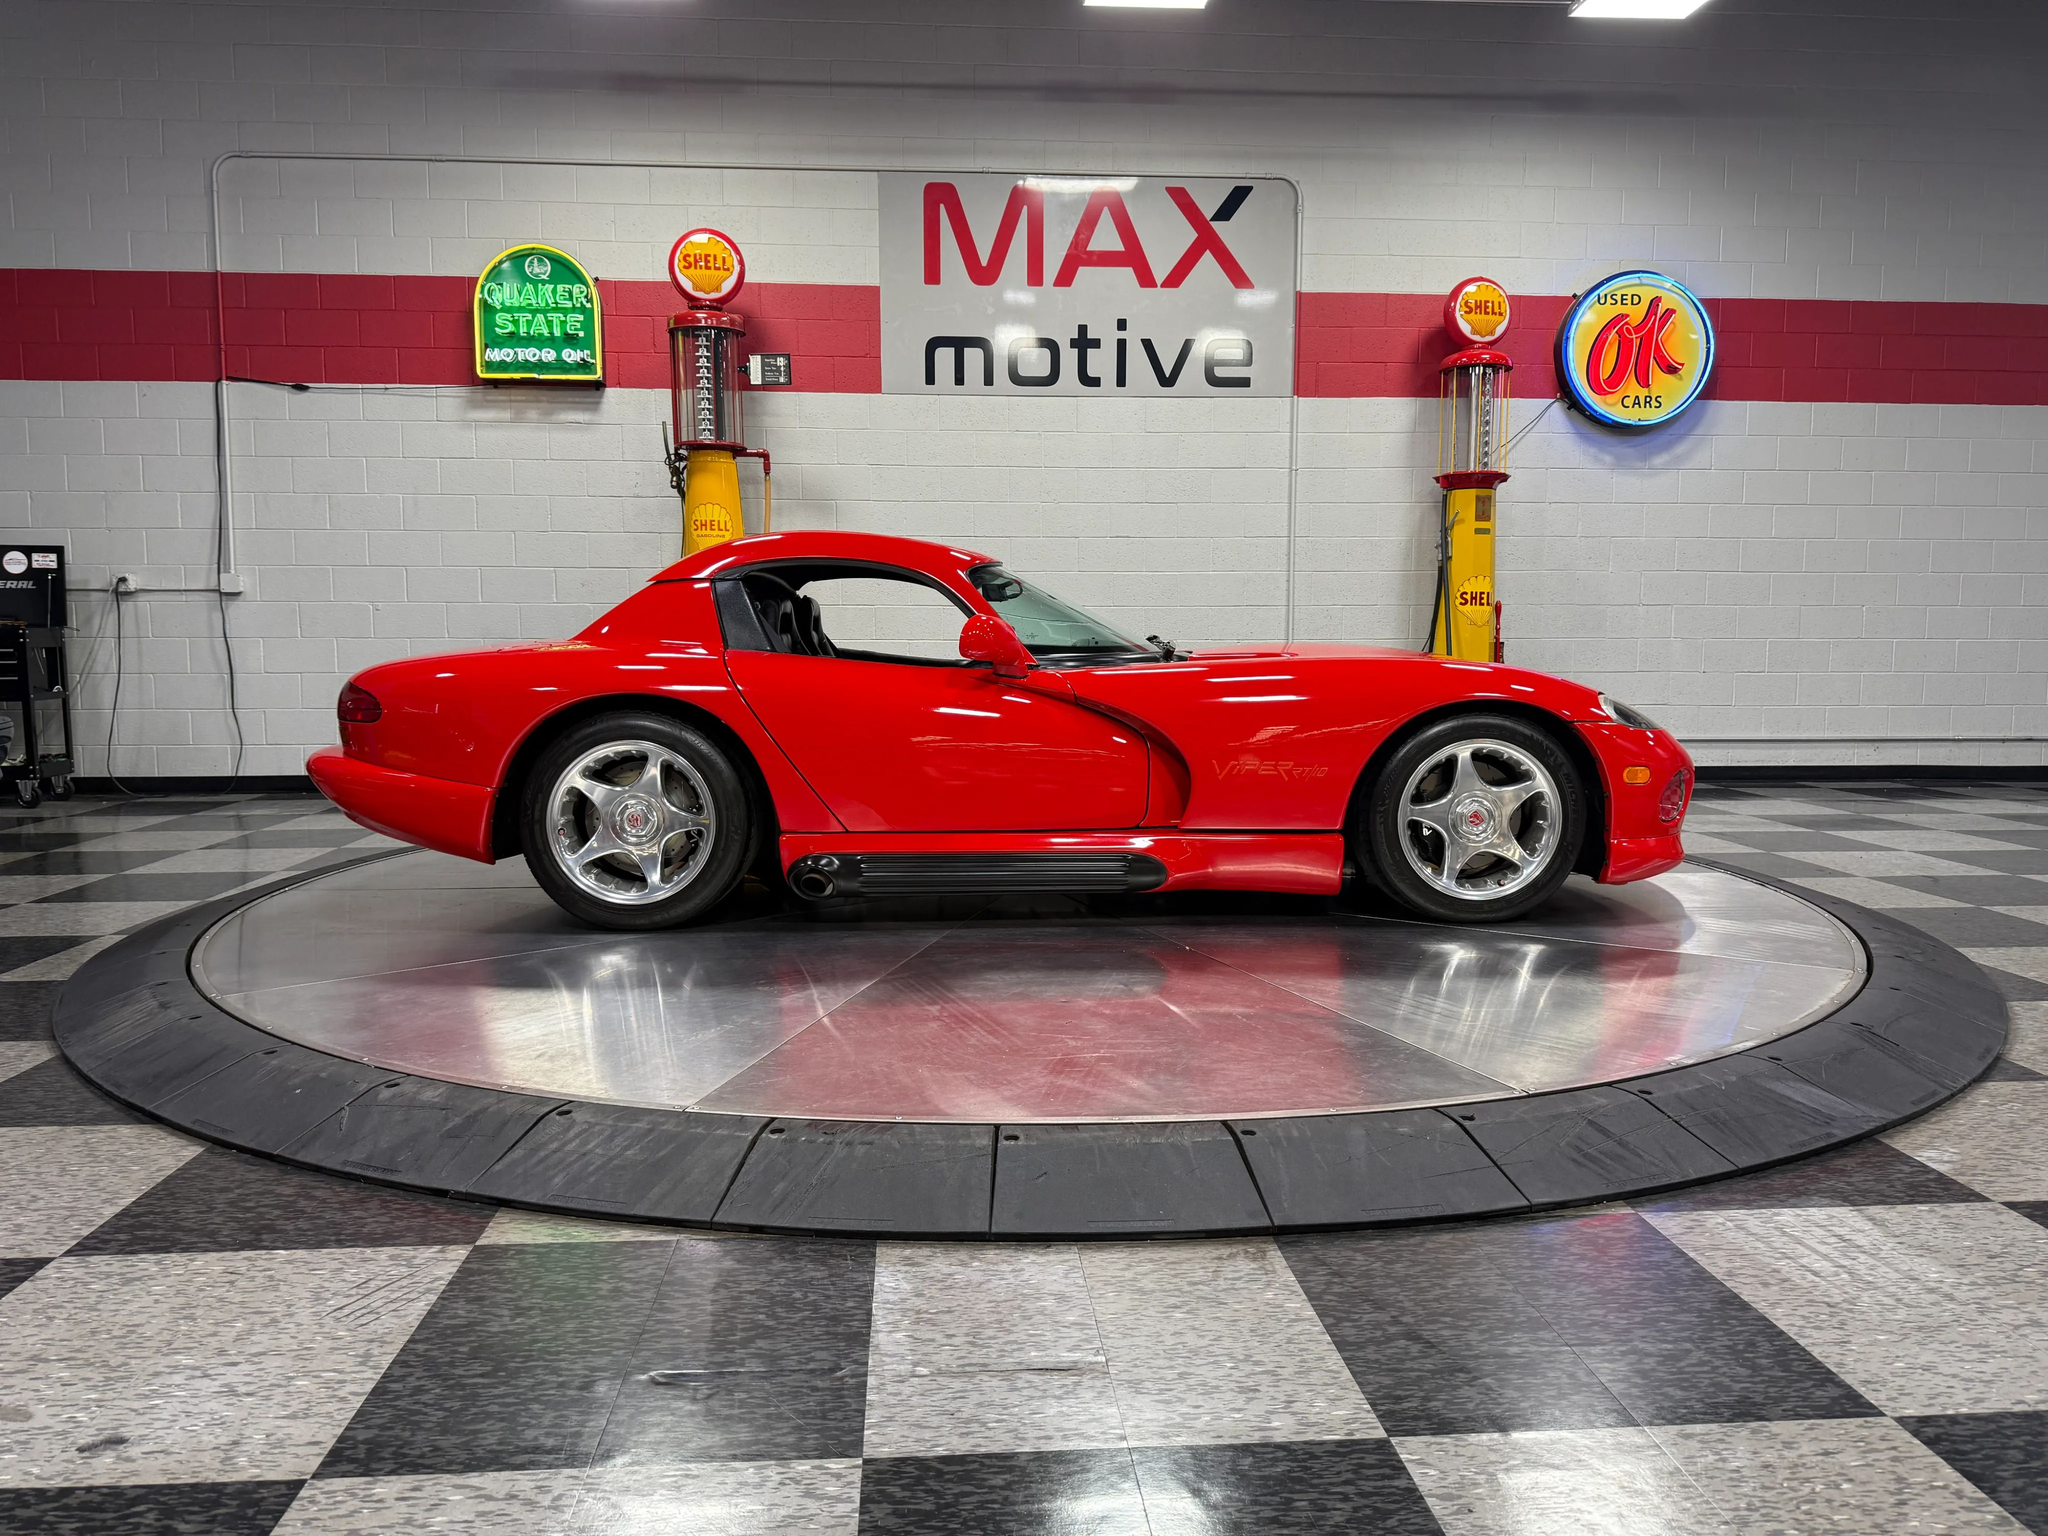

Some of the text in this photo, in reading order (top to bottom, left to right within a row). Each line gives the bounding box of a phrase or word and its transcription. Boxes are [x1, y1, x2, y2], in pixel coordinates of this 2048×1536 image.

[923, 182, 1256, 289] MAX
[682, 253, 731, 272] SHELL
[484, 282, 592, 309] QUAKER
[1597, 293, 1642, 306] USED
[1464, 299, 1504, 317] SHELL
[495, 313, 585, 337] STATE
[485, 348, 595, 363] MOTOR OIL
[924, 318, 1254, 388] motive
[1586, 296, 1685, 396] OK
[1621, 395, 1663, 409] CARS
[693, 519, 730, 532] SHELL
